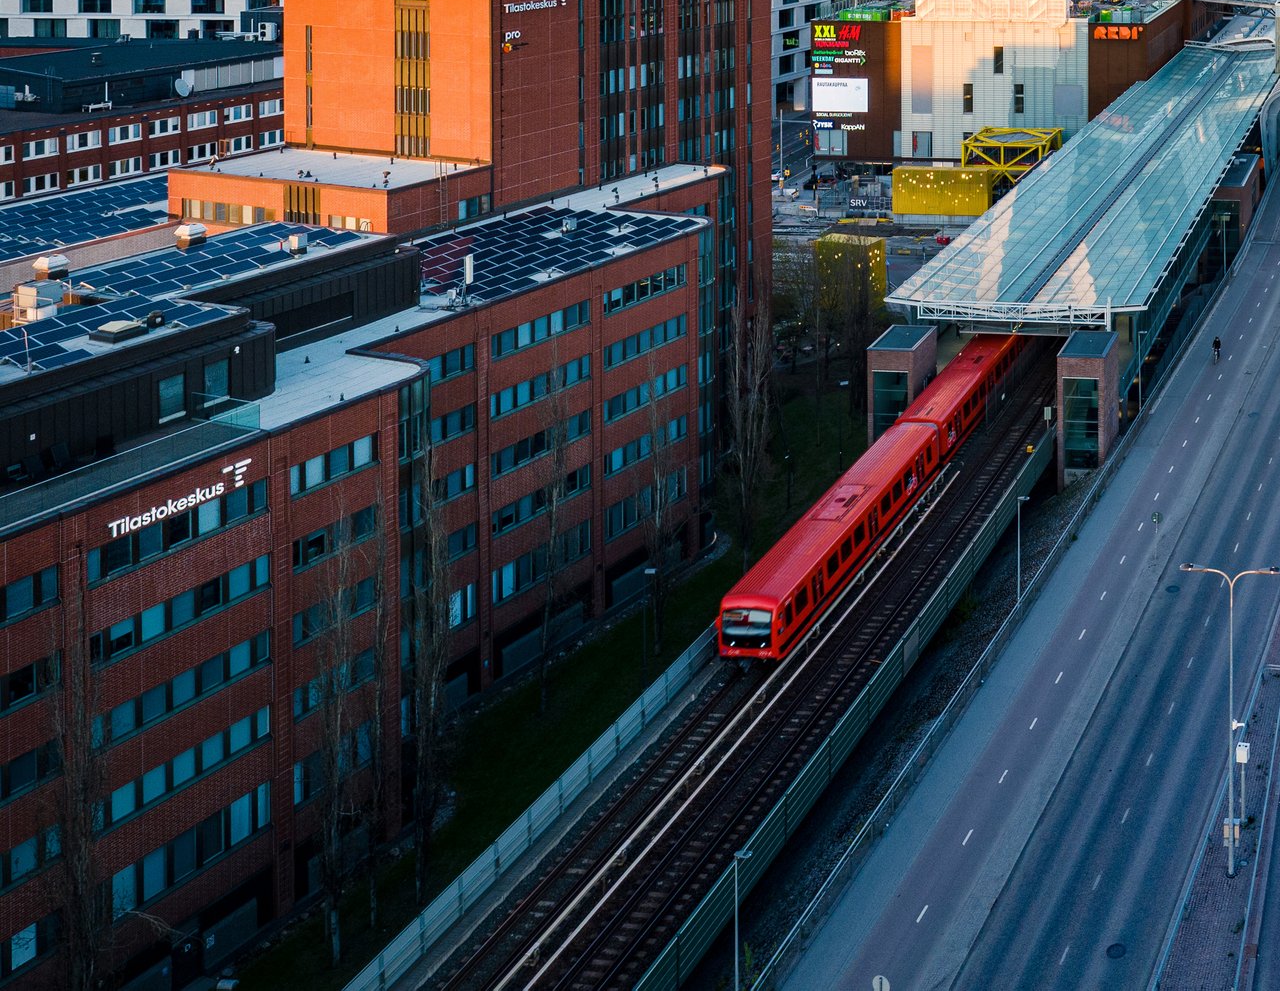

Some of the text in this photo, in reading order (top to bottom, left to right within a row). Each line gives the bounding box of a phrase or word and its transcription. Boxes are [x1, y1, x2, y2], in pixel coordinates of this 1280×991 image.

[504, 0, 557, 14] Tilastokeskus
[505, 30, 521, 42] pro
[814, 24, 861, 41] XXL H&M
[1094, 26, 1139, 39] REDI
[850, 199, 868, 207] SRV
[108, 482, 225, 538] Tilastokeskus
